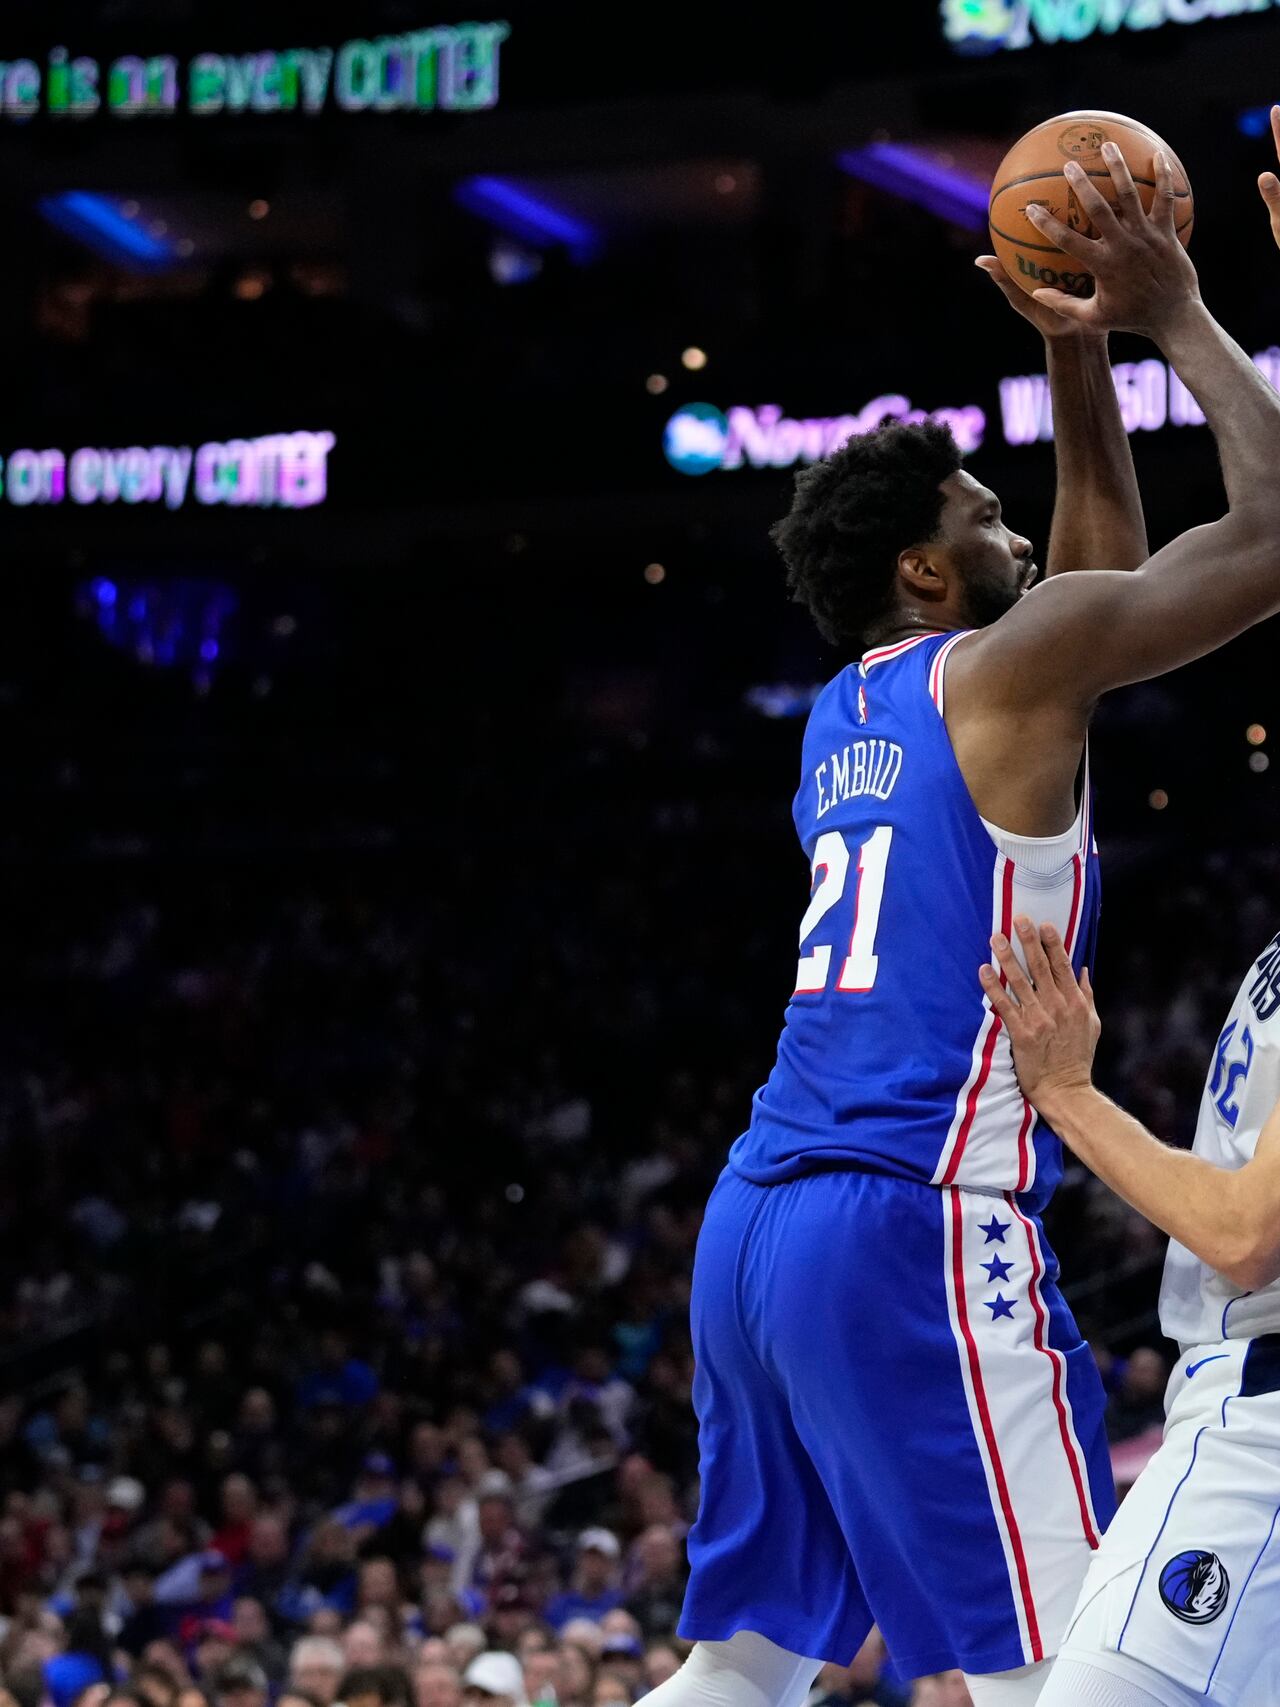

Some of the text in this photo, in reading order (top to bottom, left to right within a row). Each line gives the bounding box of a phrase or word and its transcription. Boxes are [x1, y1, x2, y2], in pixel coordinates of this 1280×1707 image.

[48, 45, 101, 114] is
[108, 55, 179, 114] on
[188, 46, 335, 117] every
[335, 19, 511, 112] corner
[6, 448, 67, 506] on
[69, 446, 193, 511] every
[194, 430, 337, 507] corner
[815, 738, 904, 820] EMBIID
[793, 825, 894, 994] 21
